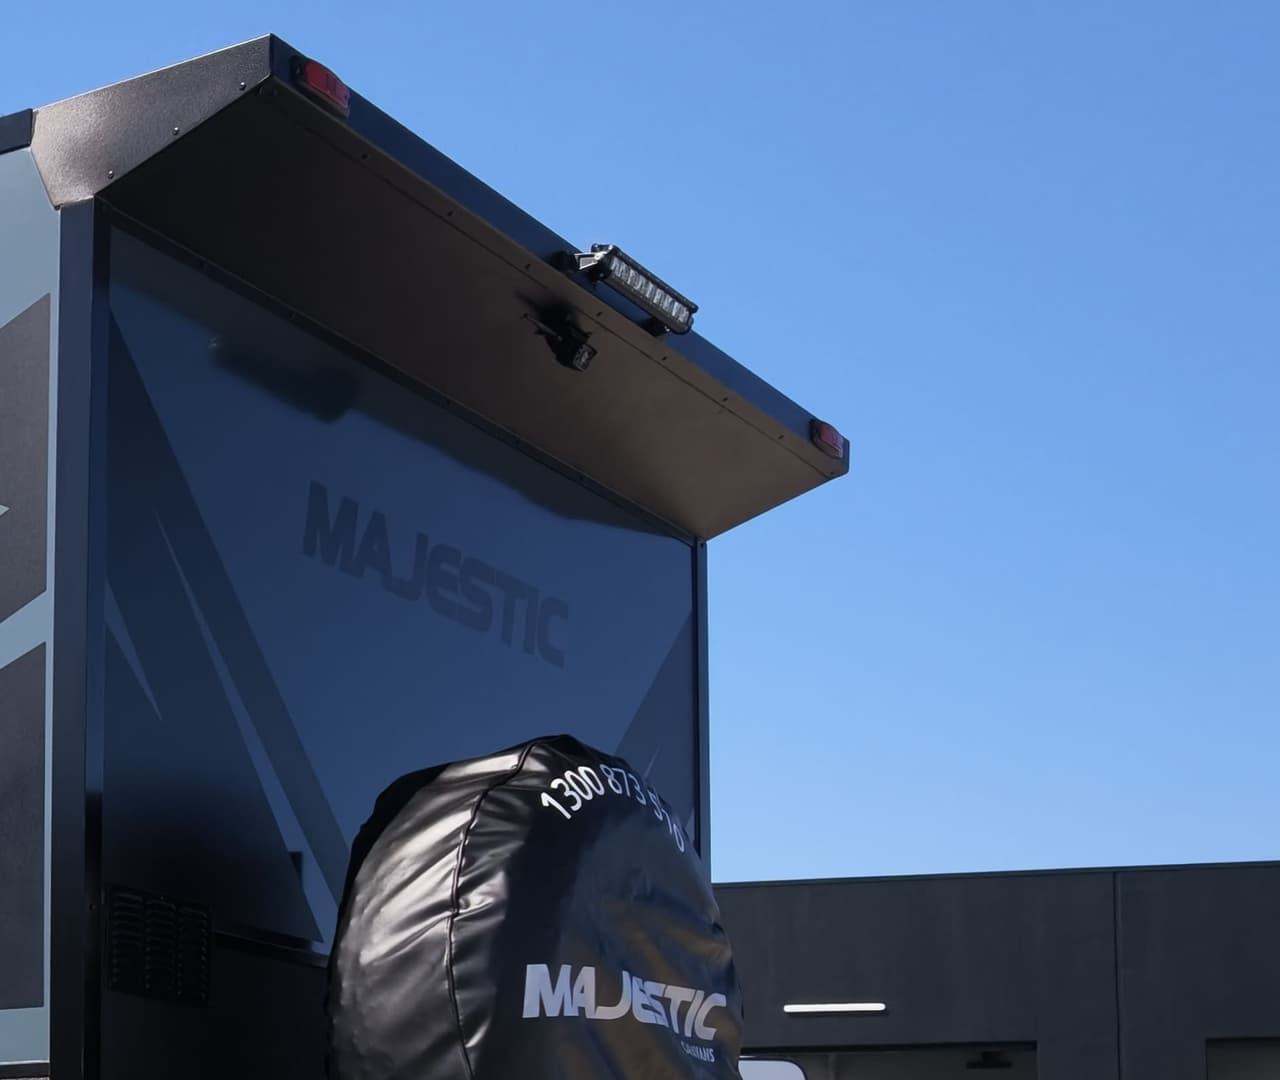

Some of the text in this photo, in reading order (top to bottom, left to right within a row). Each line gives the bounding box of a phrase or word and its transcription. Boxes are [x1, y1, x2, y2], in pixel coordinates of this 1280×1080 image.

[303, 479, 570, 671] MAJESTIC
[541, 766, 605, 820] 1300
[600, 764, 646, 806] 873
[522, 963, 727, 1041] MAJESTIC
